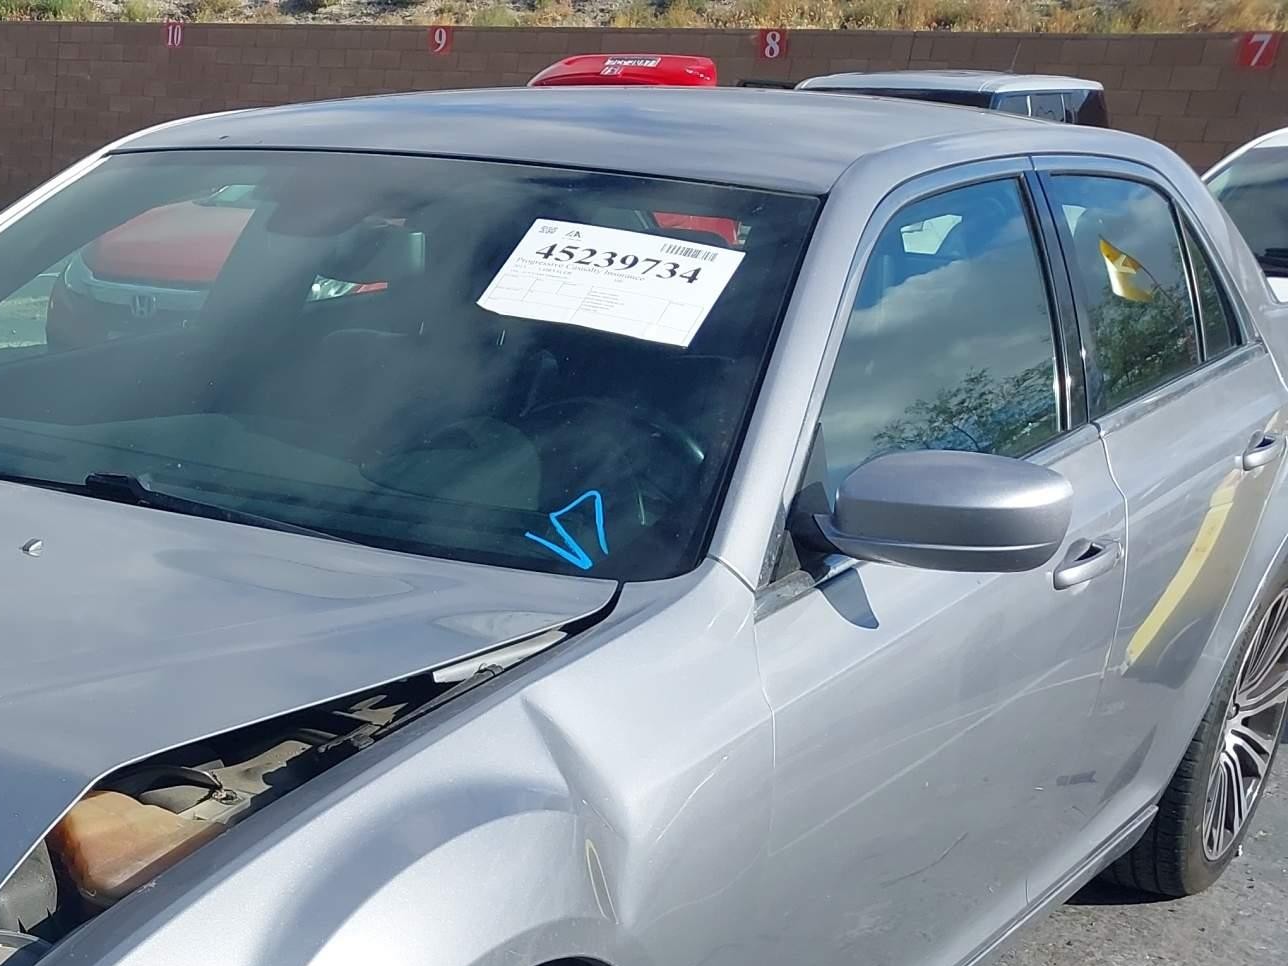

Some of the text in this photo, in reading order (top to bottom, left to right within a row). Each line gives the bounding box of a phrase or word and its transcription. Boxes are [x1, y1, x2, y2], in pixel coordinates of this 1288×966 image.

[167, 25, 182, 47] 10
[432, 27, 447, 53] 9
[764, 31, 781, 58] 8
[1247, 33, 1273, 66] 7
[535, 243, 702, 284] 45239734
